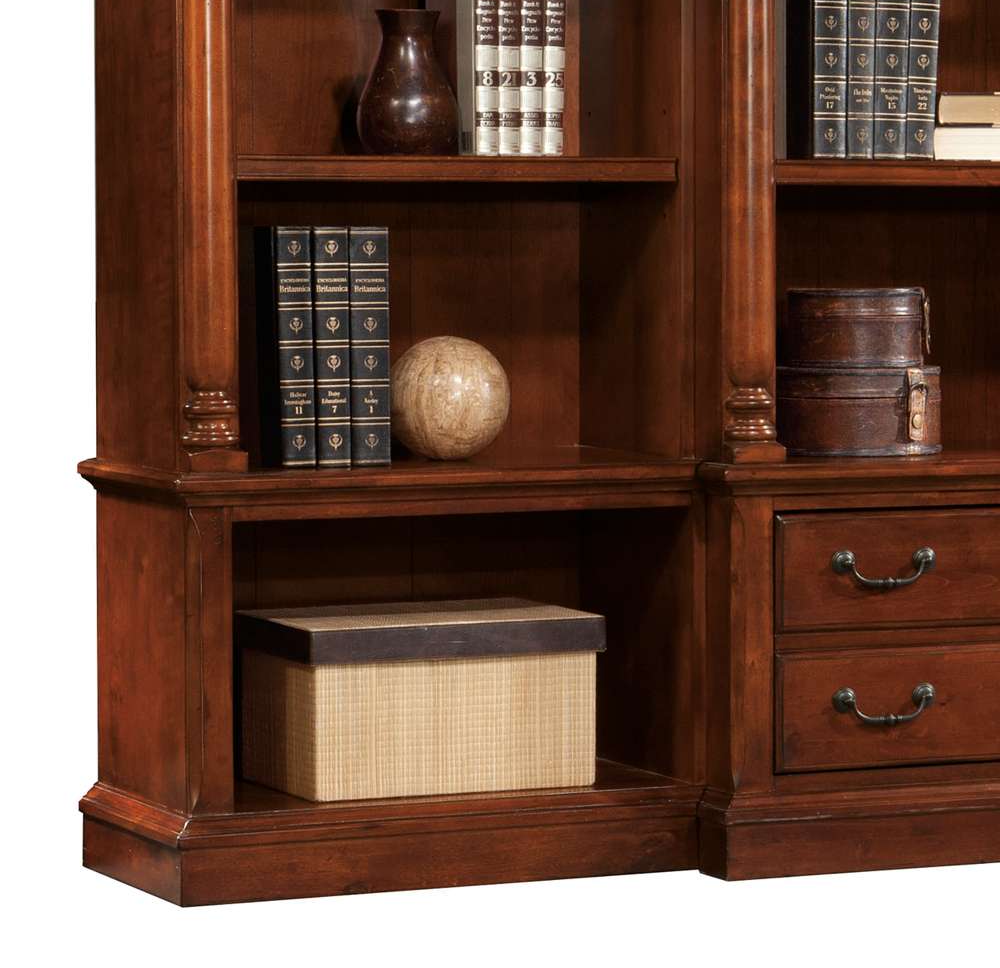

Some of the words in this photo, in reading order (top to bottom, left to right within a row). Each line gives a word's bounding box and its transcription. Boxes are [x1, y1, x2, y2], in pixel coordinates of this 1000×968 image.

[483, 72, 493, 86] 8
[526, 72, 537, 86] 3
[545, 72, 563, 87] 25
[826, 101, 834, 110] 17
[888, 102, 897, 110] 15
[917, 102, 927, 110] 22
[280, 285, 310, 293] Britannica
[316, 284, 348, 293] Britannica
[354, 285, 386, 293] Britannica
[295, 406, 303, 414] 11
[331, 405, 337, 413] 7
